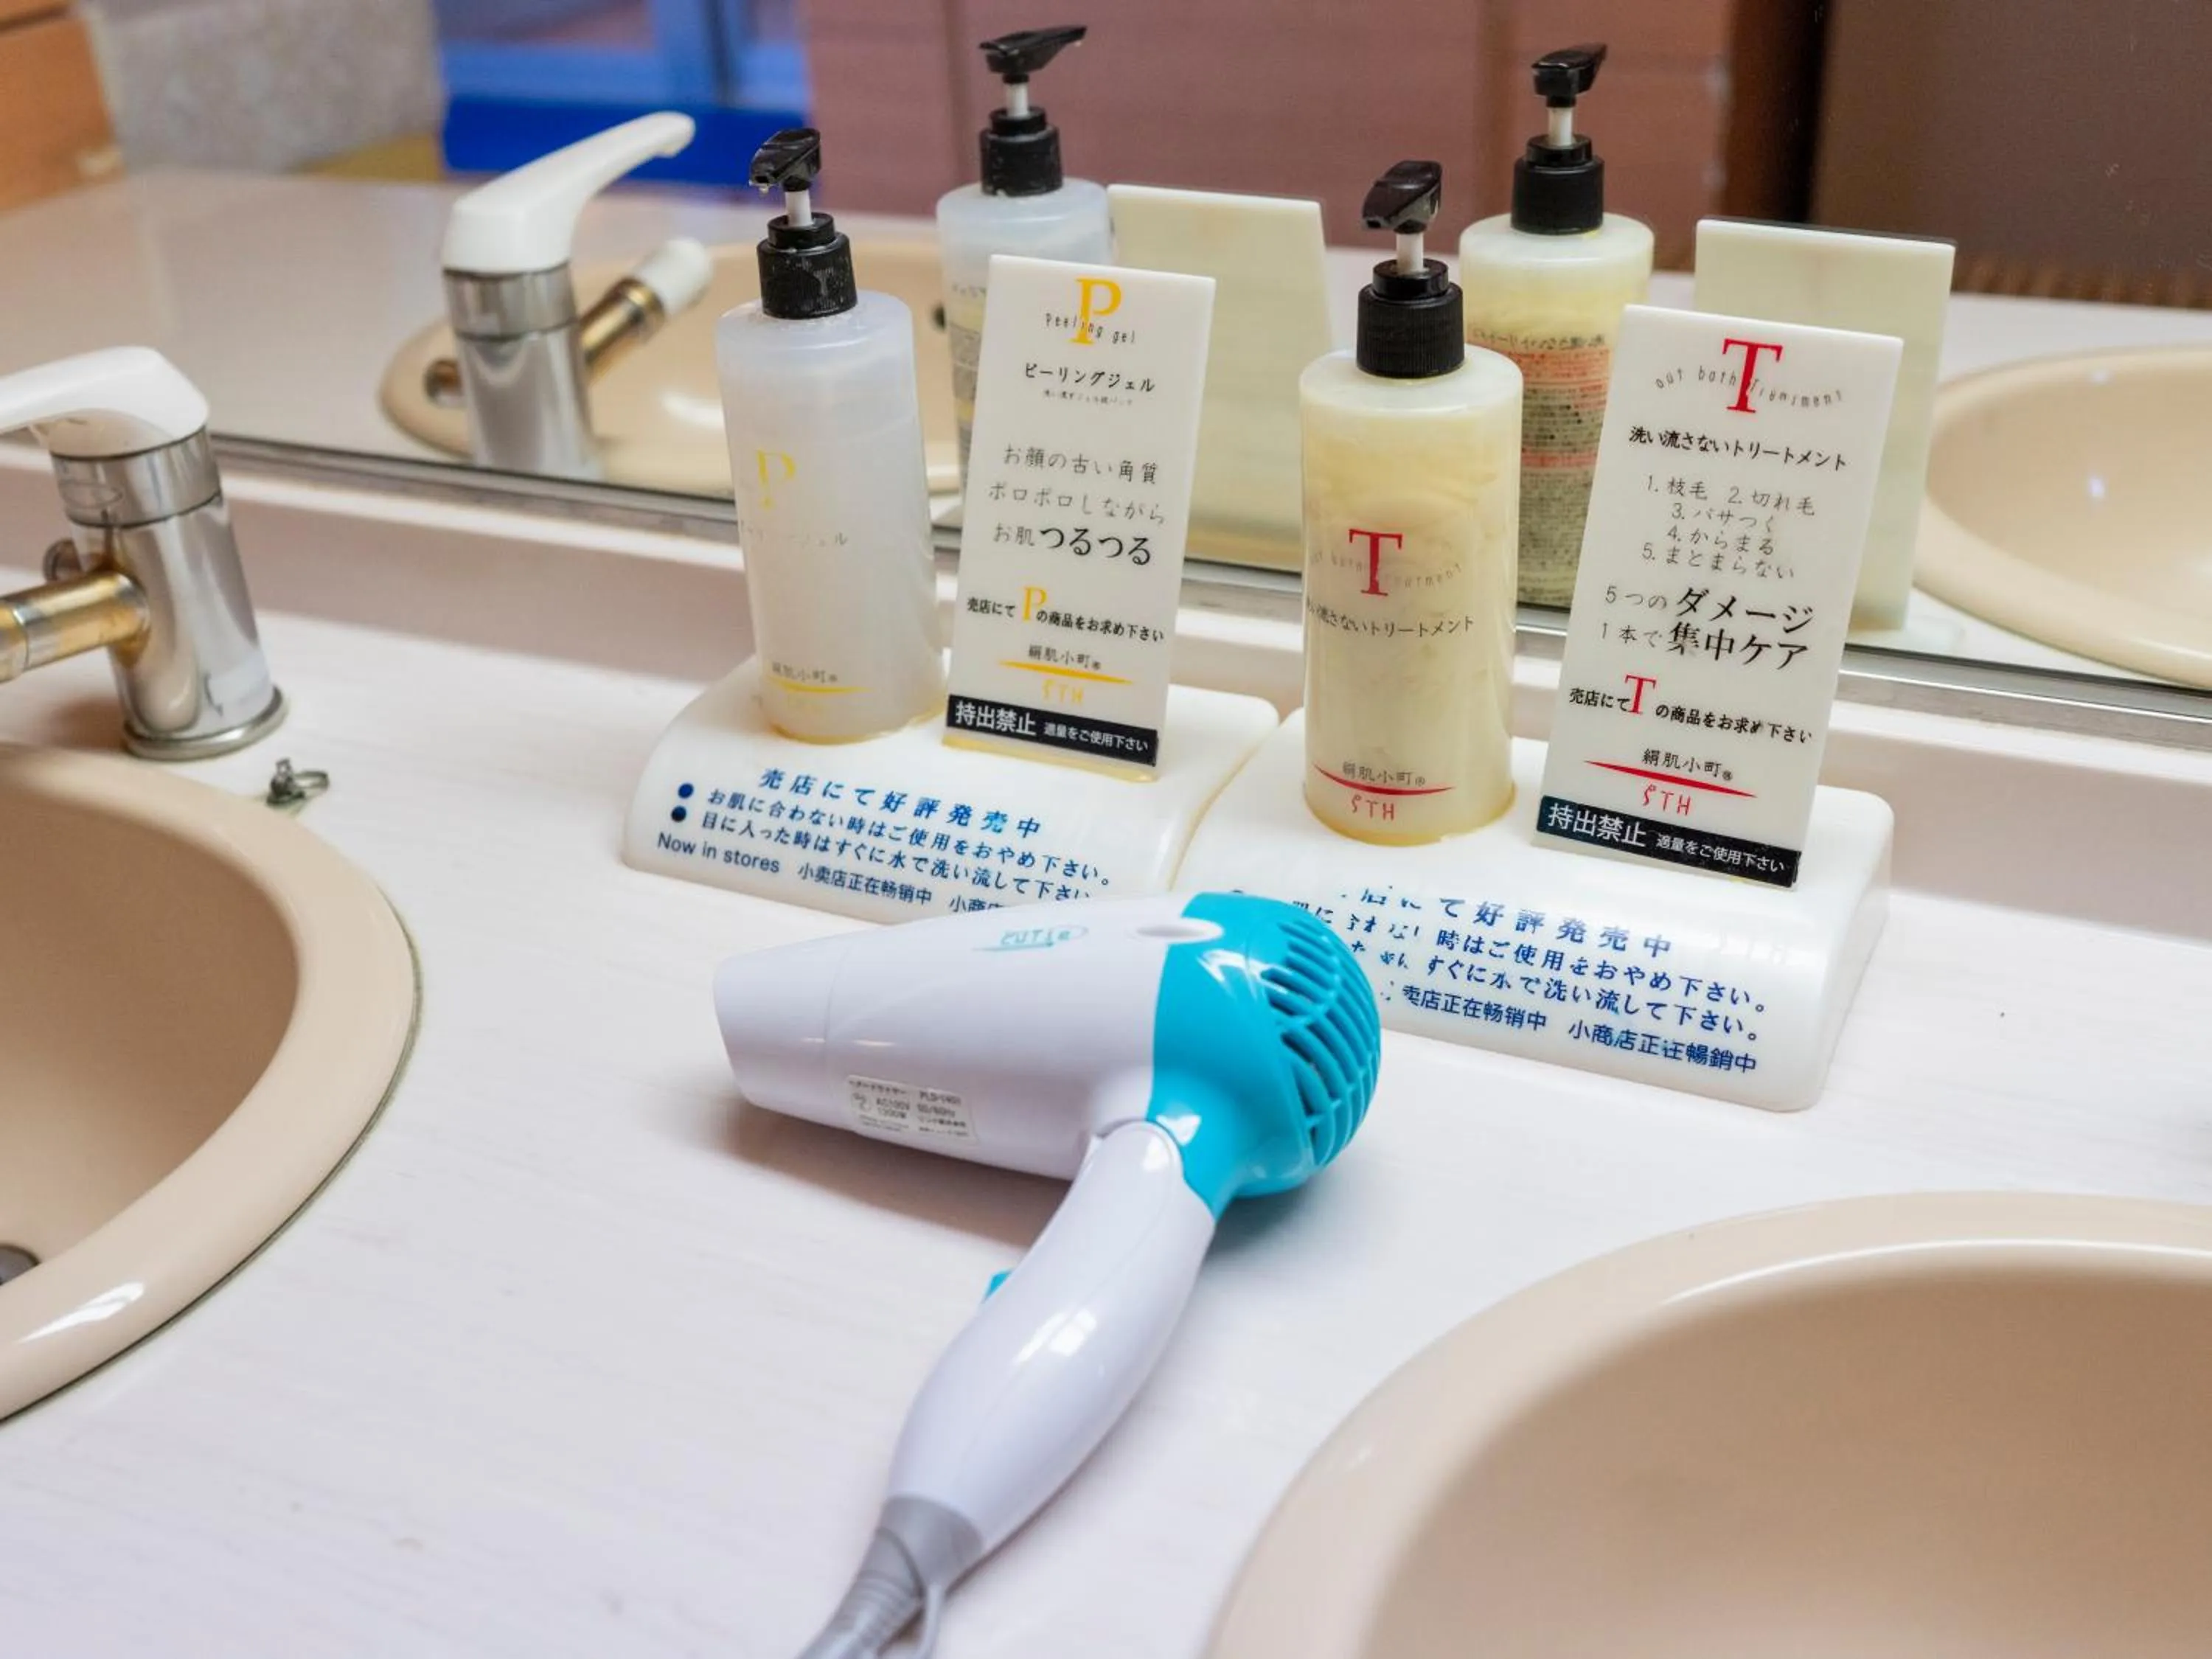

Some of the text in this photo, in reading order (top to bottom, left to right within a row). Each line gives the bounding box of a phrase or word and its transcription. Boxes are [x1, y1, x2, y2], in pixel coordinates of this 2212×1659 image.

[1071, 276, 1123, 345] P
[1112, 329, 1135, 344] gel
[1025, 362, 1155, 393] ピーリングジェル
[1722, 337, 1783, 414] T
[1003, 444, 1158, 485] お顔の古い角質
[1628, 425, 1848, 470] 洗い流さないトリートメント
[1348, 529, 1403, 597] T
[955, 700, 1149, 752] 持出禁止 適量をご使用下さい
[758, 766, 1041, 839] 売店にて好評発売中
[657, 831, 696, 855] Now
[702, 841, 717, 860] in
[723, 846, 781, 874] stores
[1548, 802, 1786, 873] 持出禁止 適量をご使用下さい
